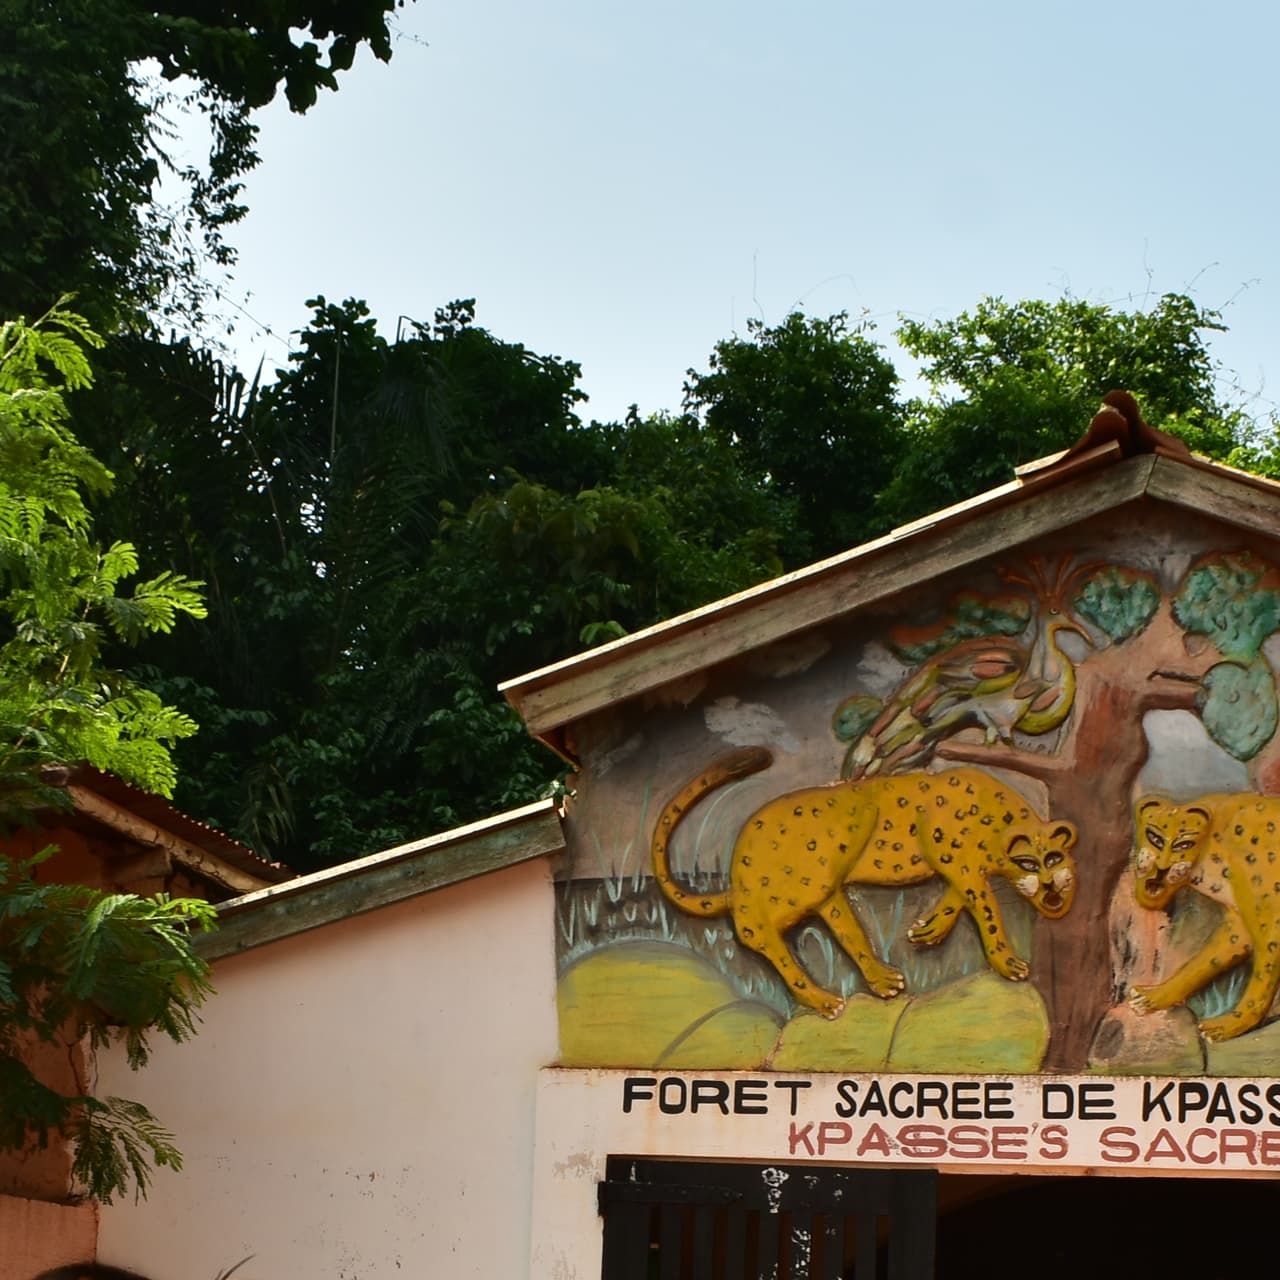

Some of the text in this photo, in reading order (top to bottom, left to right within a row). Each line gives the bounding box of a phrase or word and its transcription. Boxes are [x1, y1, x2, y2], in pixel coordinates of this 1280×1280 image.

[623, 1076, 813, 1116] FORET
[834, 1080, 1015, 1120] SACREE
[1041, 1082, 1117, 1121] DE
[788, 1121, 1070, 1161] KPASSE'S
